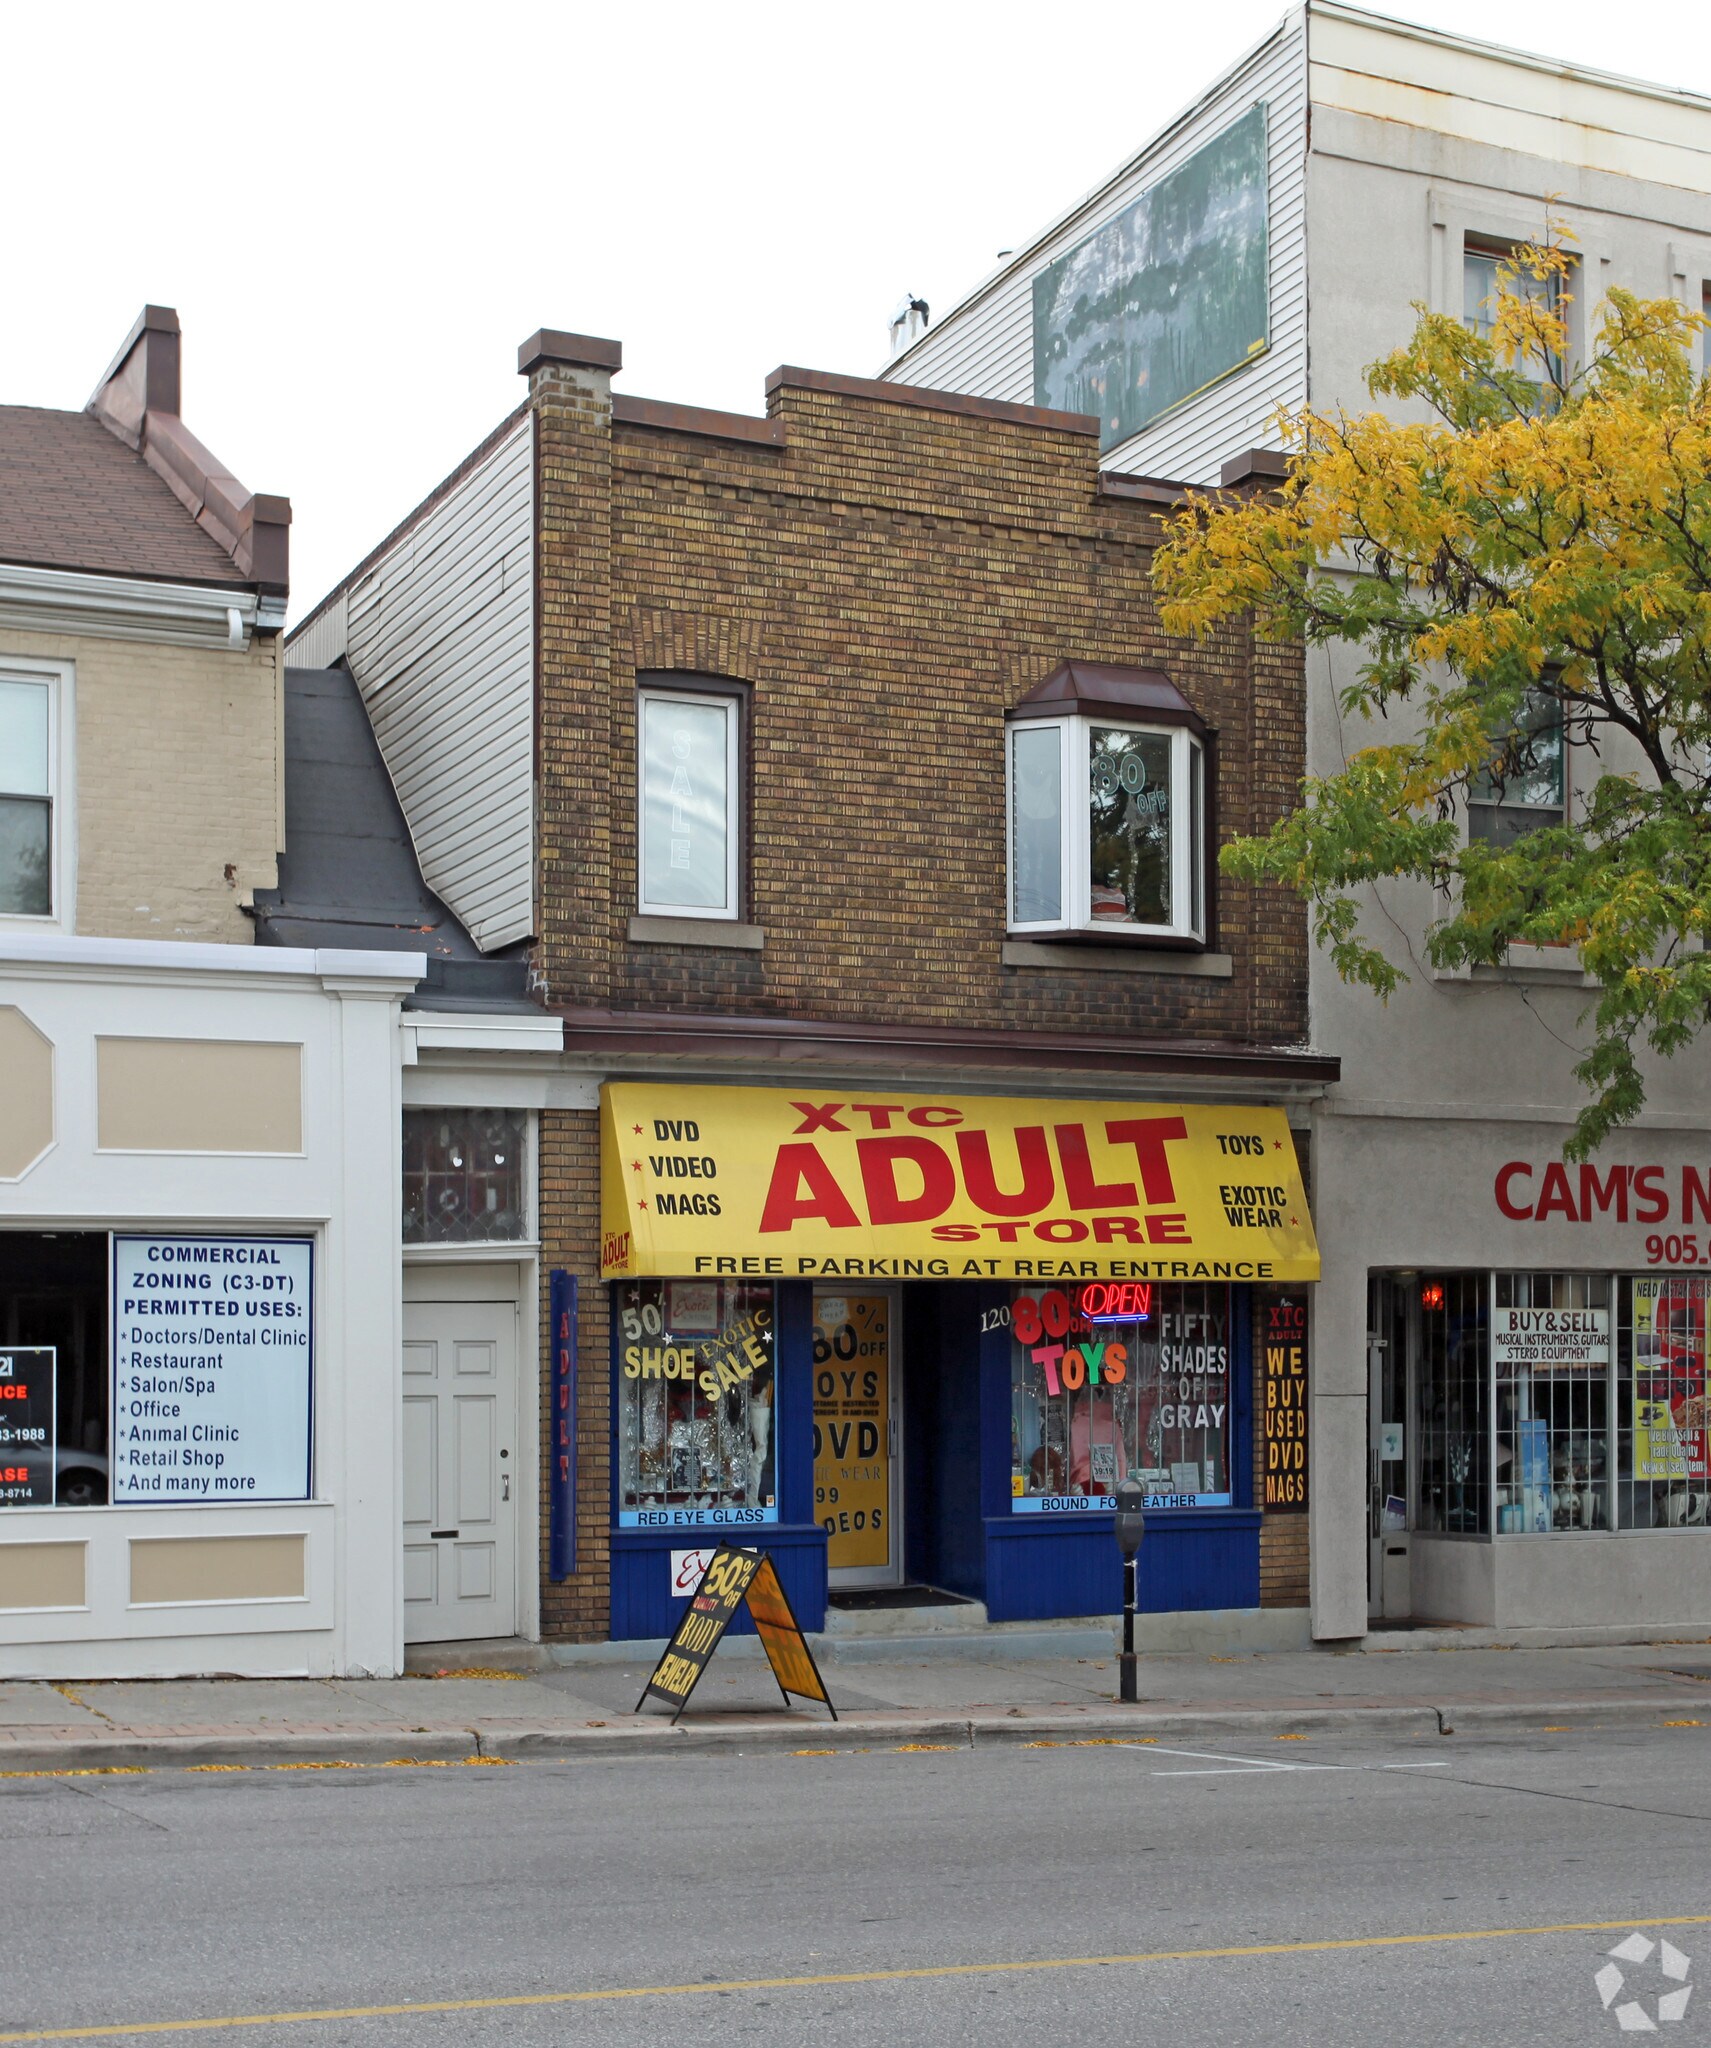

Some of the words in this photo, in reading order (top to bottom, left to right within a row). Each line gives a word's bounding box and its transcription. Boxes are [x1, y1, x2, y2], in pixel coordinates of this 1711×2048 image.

[1091, 751, 1146, 796] 80
[1136, 790, 1168, 815] OFF
[670, 729, 692, 870] SALE
[788, 1101, 964, 1134] XTC
[653, 1120, 700, 1142] DVD
[1216, 1134, 1264, 1156] TOYS
[649, 1155, 717, 1179] VIDEO
[758, 1116, 1188, 1233] ADULT
[655, 1193, 721, 1216] MAGS
[1219, 1185, 1287, 1207] EXOTIC
[1494, 1161, 1669, 1225] CAM'S
[931, 1213, 1193, 1245] STORE
[1224, 1207, 1283, 1228] WEAR
[147, 1246, 281, 1265] COMMERCIAL
[602, 1231, 630, 1269] ADULT
[695, 1256, 784, 1274] FREE
[798, 1257, 949, 1276] PARKING
[961, 1259, 1002, 1276] AT
[1014, 1260, 1098, 1277] REAR
[1110, 1261, 1274, 1278] ENTRANCE
[132, 1272, 212, 1290] ZONING
[223, 1275, 294, 1294] (C3-DT)
[124, 1300, 239, 1316] PERMITTED
[245, 1301, 302, 1318] USES:
[1082, 1284, 1150, 1315] OPEN
[981, 1305, 1011, 1333] 120
[1162, 1313, 1225, 1338] FIFTY
[1269, 1307, 1305, 1327] XTC
[131, 1327, 256, 1346] Doctors/Dental
[261, 1329, 307, 1347] Clinic
[701, 1309, 771, 1359] EXOTIC
[1268, 1331, 1302, 1340] ADULT
[1496, 1333, 1522, 1346] MUSICAL
[1581, 1334, 1610, 1346] GUITARS
[131, 1352, 223, 1370] Restaurant
[860, 1342, 887, 1357] OFF
[1160, 1346, 1226, 1374] SHADES
[1267, 1347, 1302, 1375] WE
[1507, 1347, 1538, 1359] STEREO
[1541, 1347, 1591, 1360] EQUIPTMENT
[624, 1346, 695, 1380] SHOE
[699, 1335, 768, 1402] SALE
[1031, 1342, 1127, 1396] TOYS
[130, 1376, 215, 1397] Salon/Spa
[817, 1370, 878, 1398] OYS
[1178, 1377, 1202, 1401] OF
[1267, 1379, 1305, 1409] BUY
[130, 1400, 181, 1418] Office
[560, 1312, 569, 1482] ADULT
[1160, 1404, 1225, 1429] GRAY
[1266, 1410, 1304, 1438] USED
[129, 1425, 187, 1442] Animal
[192, 1425, 240, 1442] Clinic
[129, 1450, 178, 1467] Retail
[182, 1450, 225, 1469] Shop
[1269, 1442, 1304, 1469] DVD
[1672, 1443, 1698, 1458] Quaity
[128, 1474, 161, 1491] And
[165, 1477, 210, 1494] many
[215, 1477, 256, 1490] more
[1266, 1474, 1304, 1503] MAGS
[1041, 1497, 1089, 1511] BOUND
[1100, 1497, 1117, 1509] FO
[1143, 1495, 1196, 1508] EATHER
[638, 1511, 668, 1526] RED
[674, 1511, 705, 1525] EYE
[712, 1509, 764, 1524] GLASS
[704, 1552, 756, 1597] 50%
[675, 1612, 724, 1655] BODY
[651, 1653, 700, 1697] JEWELRY
